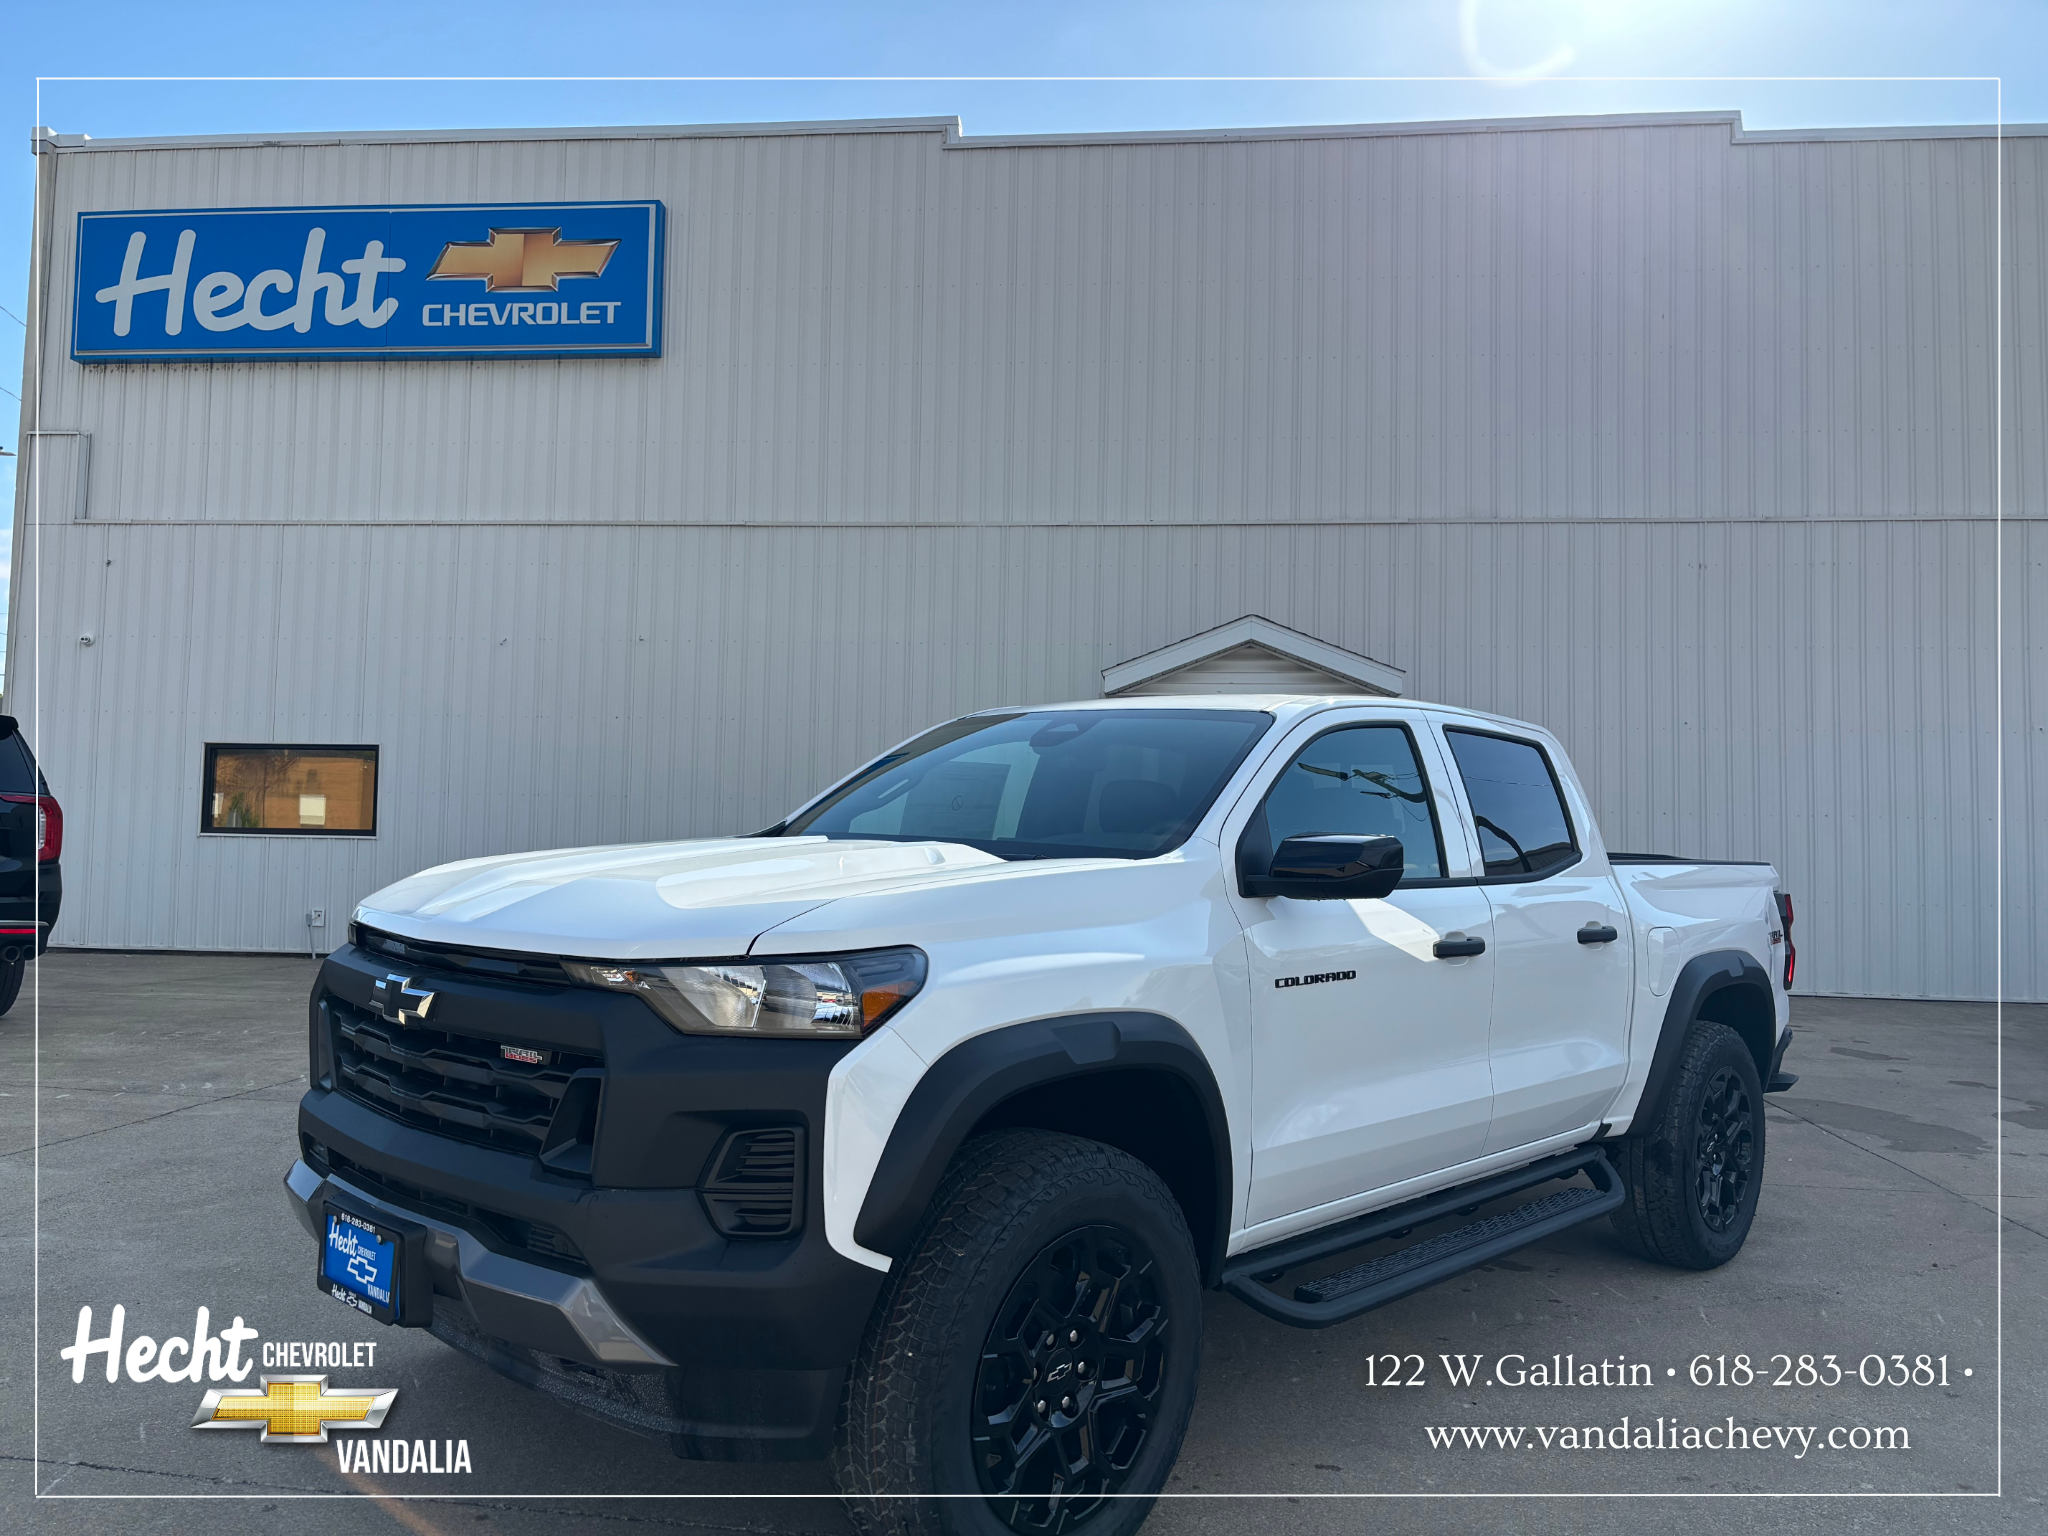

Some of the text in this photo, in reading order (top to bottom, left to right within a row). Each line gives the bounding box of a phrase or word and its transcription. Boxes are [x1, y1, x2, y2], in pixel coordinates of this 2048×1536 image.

[96, 227, 407, 336] Hecht
[422, 301, 622, 327] CHEVROLET
[1274, 970, 1357, 989] COLORADO
[329, 1221, 359, 1258] Hecht
